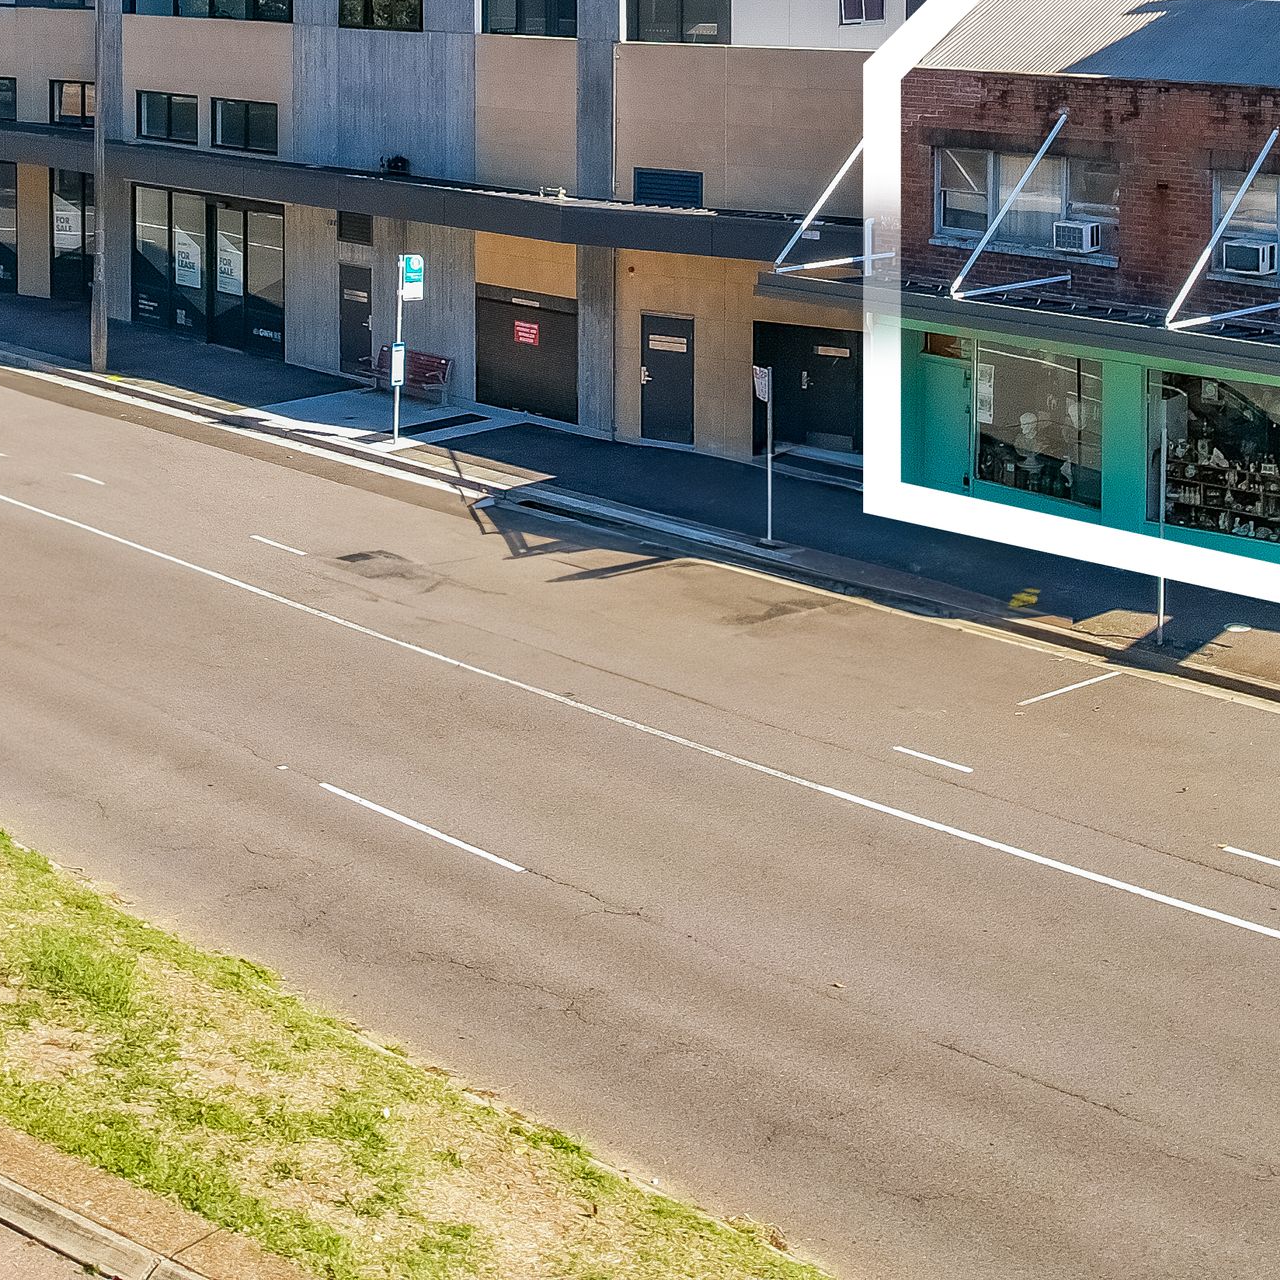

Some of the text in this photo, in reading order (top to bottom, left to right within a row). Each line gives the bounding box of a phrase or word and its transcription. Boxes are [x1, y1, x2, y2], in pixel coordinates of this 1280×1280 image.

[55, 216, 70, 224] FOR
[55, 224, 72, 232] SALE
[177, 250, 190, 260] FOR
[177, 260, 196, 271] LEASE
[219, 257, 232, 267] FOR
[219, 266, 234, 277] SALE
